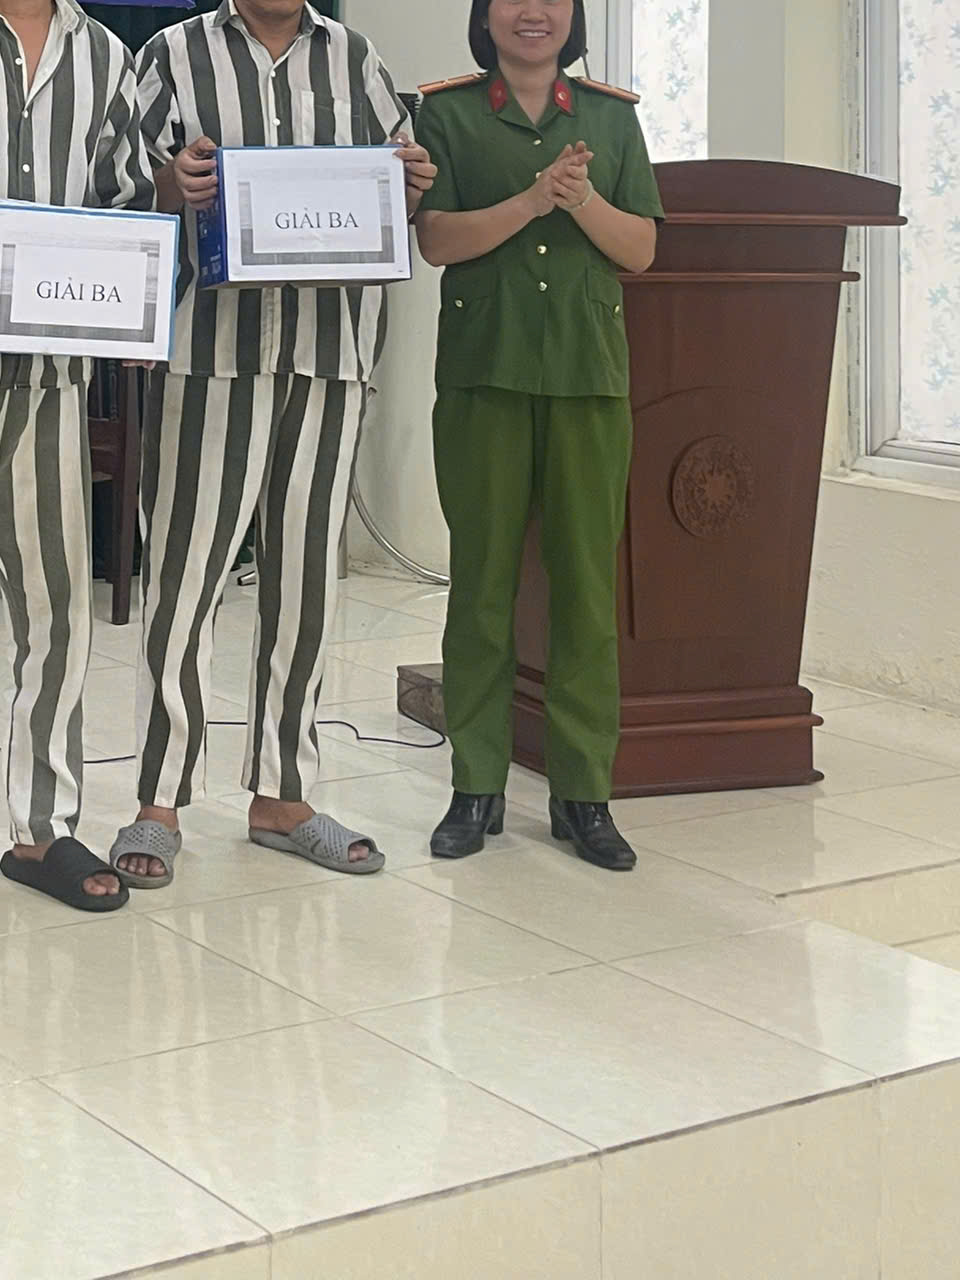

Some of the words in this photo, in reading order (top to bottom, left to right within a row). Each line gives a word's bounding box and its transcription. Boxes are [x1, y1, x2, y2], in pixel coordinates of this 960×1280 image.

[275, 207, 322, 230] GIẢI
[328, 211, 359, 229] BA
[36, 276, 84, 301] GIẢI
[92, 284, 122, 303] BA
